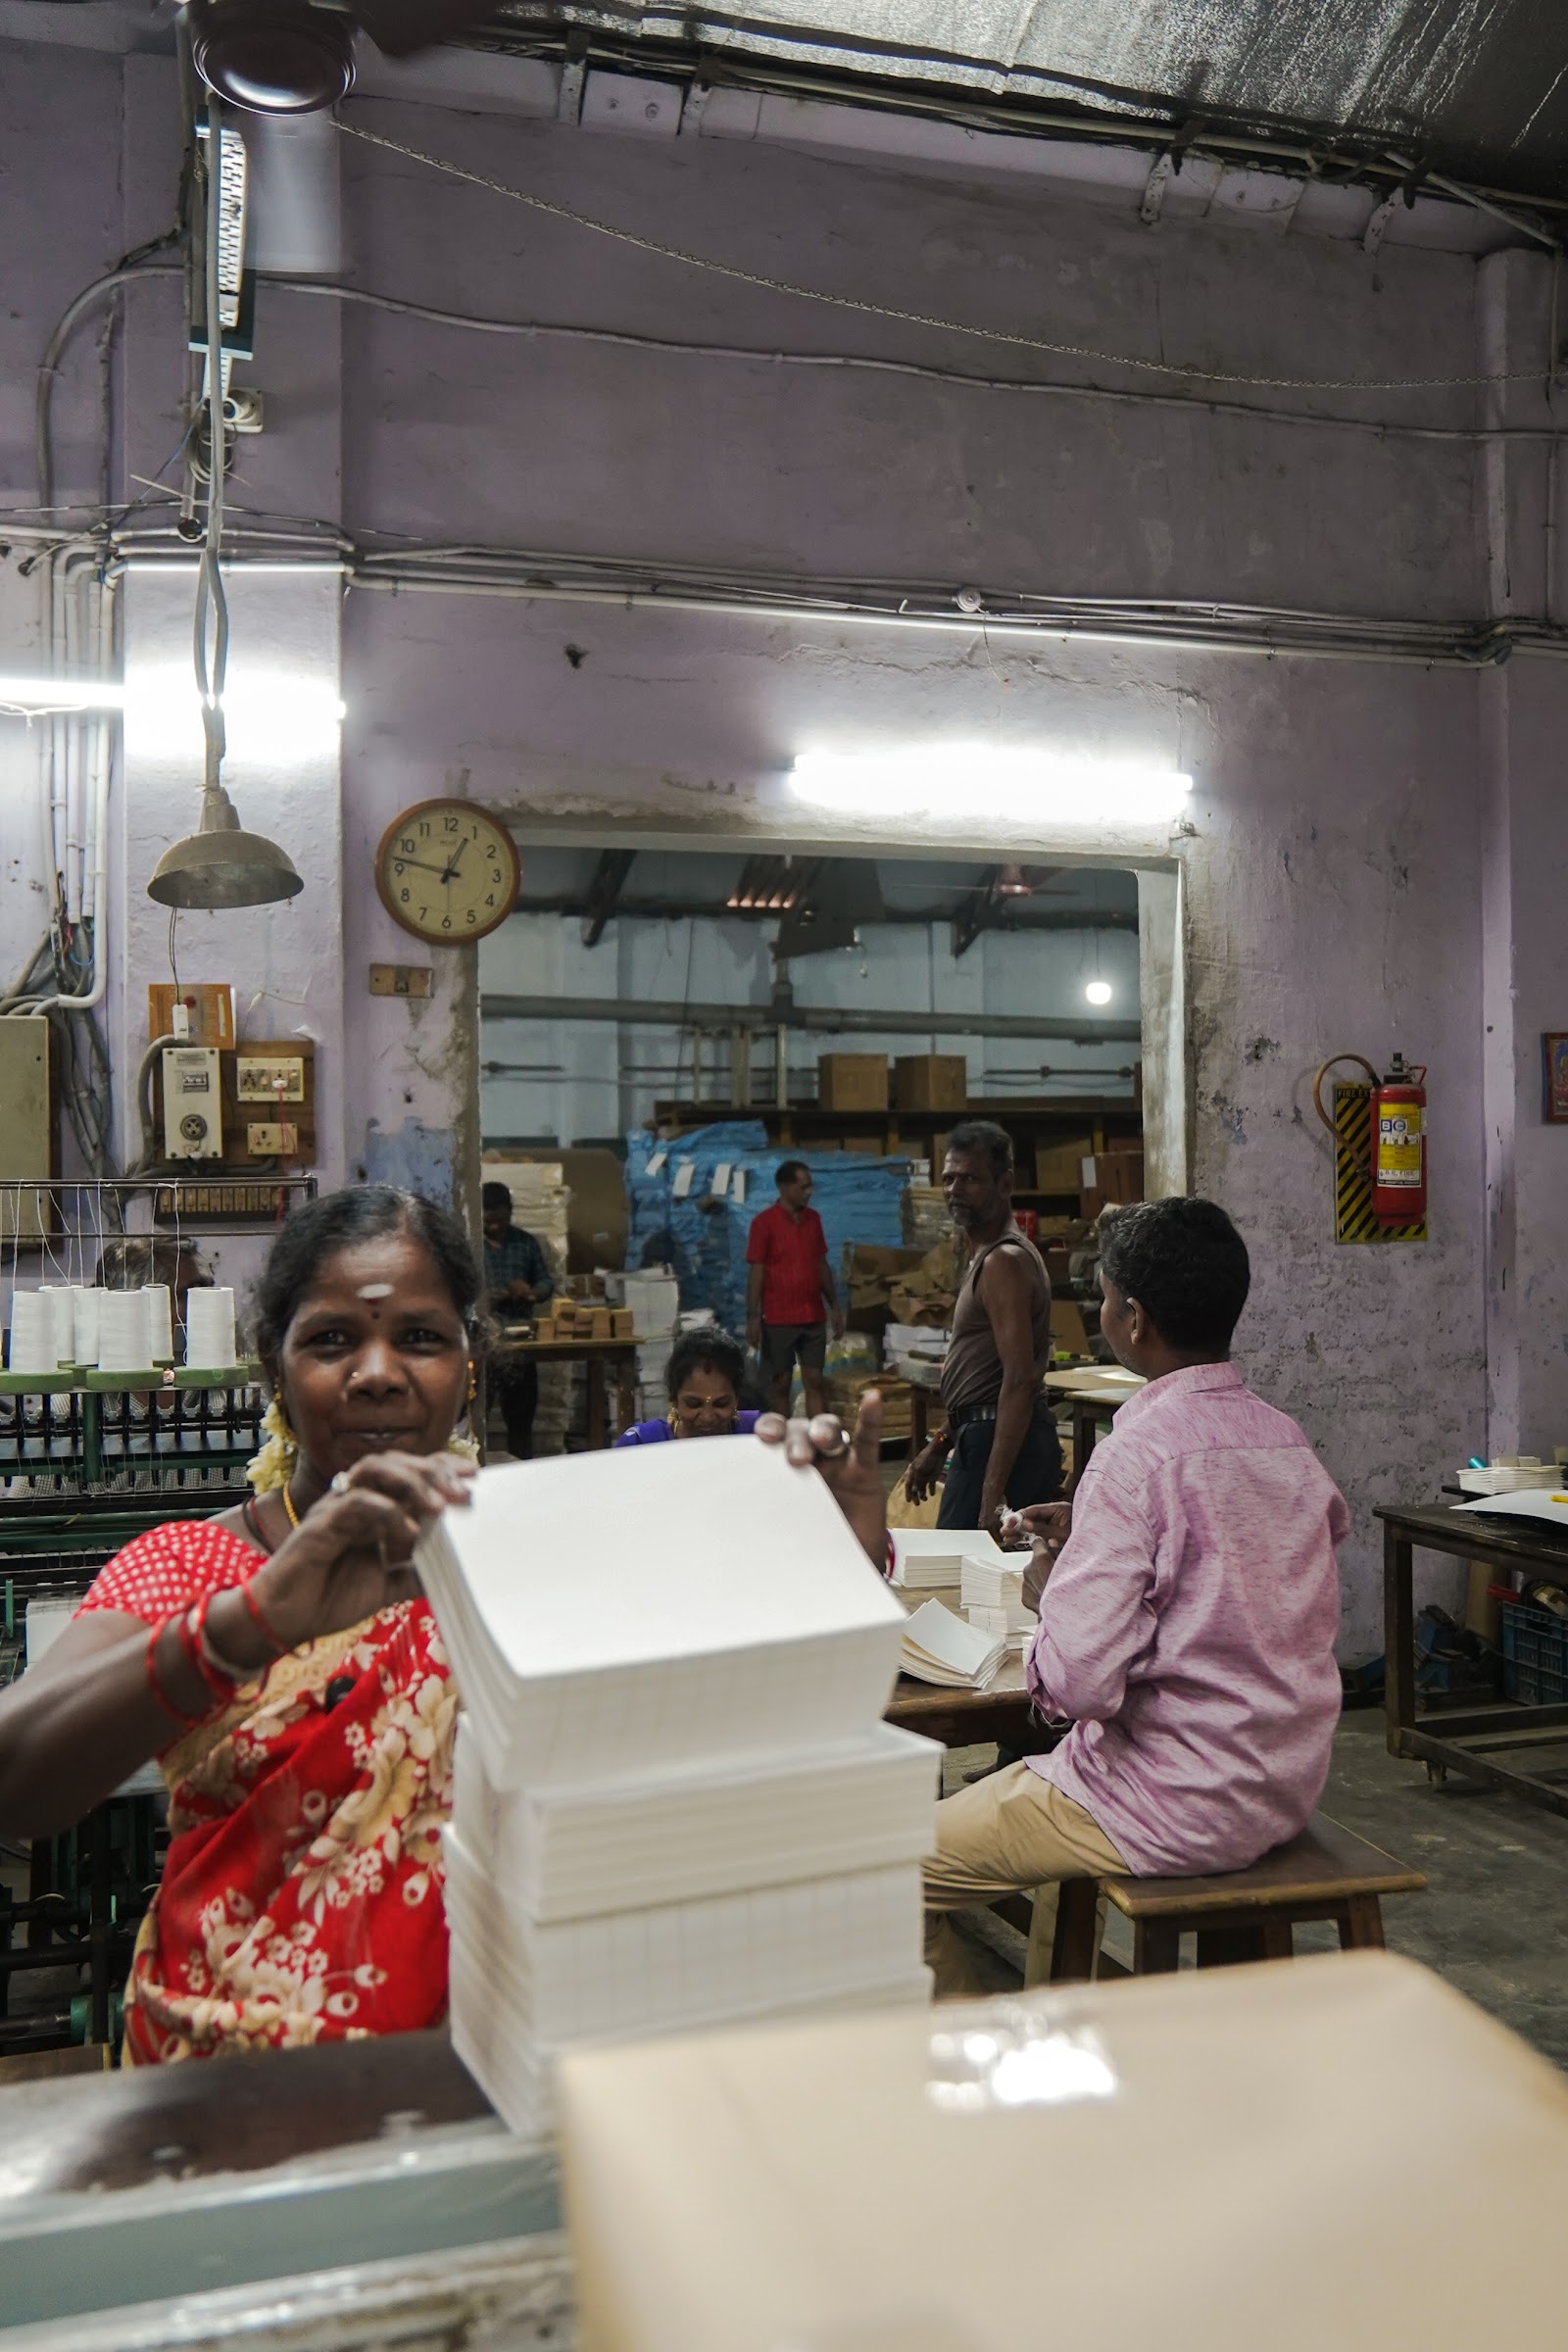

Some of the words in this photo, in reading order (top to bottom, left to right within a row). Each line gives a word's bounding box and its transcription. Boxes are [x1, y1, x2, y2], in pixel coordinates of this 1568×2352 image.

[419, 823, 430, 837] 11
[443, 817, 458, 831] 12
[471, 826, 477, 839] 1
[400, 839, 415, 854] 10
[486, 845, 496, 858] 2
[394, 863, 404, 877] 9
[493, 869, 502, 883] 3
[401, 888, 410, 902] 8
[485, 894, 494, 907] 4
[419, 907, 428, 921] 7
[466, 910, 476, 923] 5
[442, 915, 451, 929] 6
[1382, 1120, 1391, 1131] B
